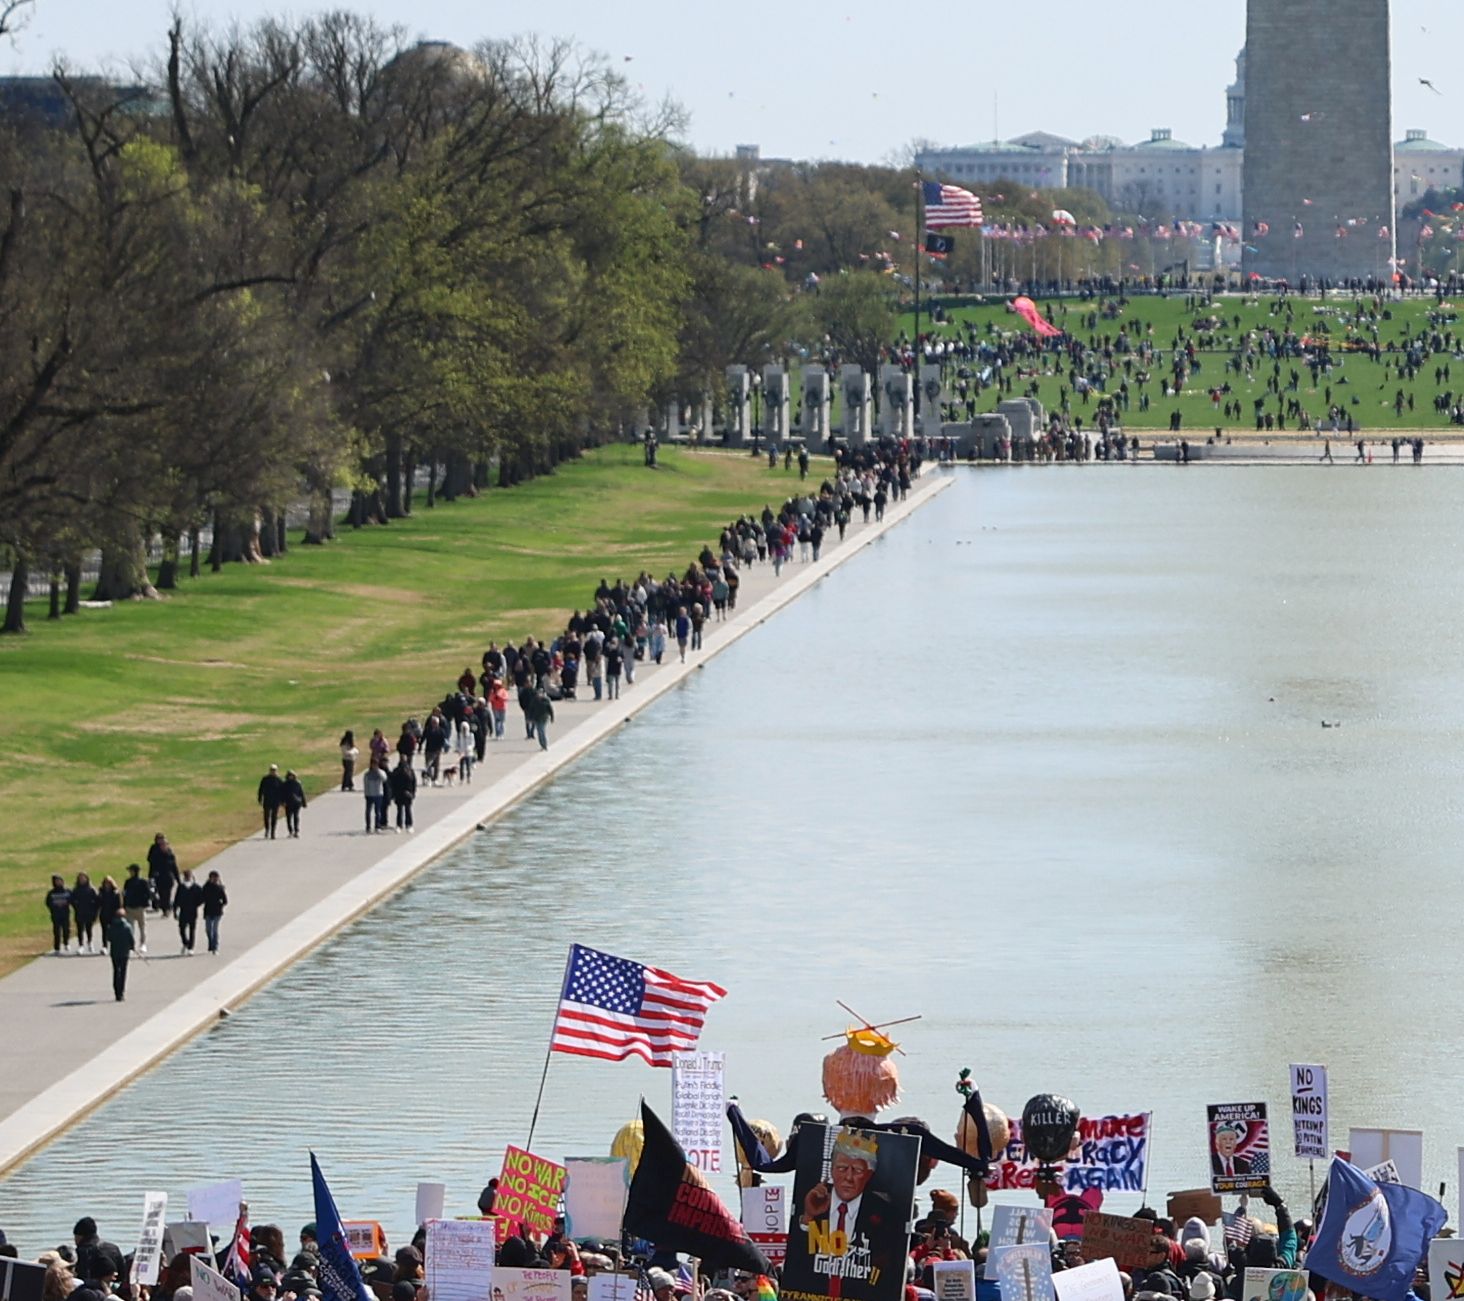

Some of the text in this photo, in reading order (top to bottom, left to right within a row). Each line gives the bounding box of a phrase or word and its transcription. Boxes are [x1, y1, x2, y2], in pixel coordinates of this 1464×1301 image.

[1296, 1067, 1314, 1086] NO
[1217, 1105, 1244, 1113] WAKE
[1292, 1095, 1323, 1115] KINGS
[1030, 1112, 1071, 1127] KILLER
[1214, 1111, 1261, 1121] AMERICA!
[1301, 1119, 1324, 1134] TRUMP
[1303, 1133, 1323, 1145] PUTIN
[504, 1150, 567, 1192] NO WAR
[1067, 1162, 1145, 1192] AGAIN
[499, 1172, 559, 1209] NO ICE
[492, 1193, 520, 1215] NO
[1086, 1212, 1136, 1231] NO KINGS
[1089, 1228, 1148, 1245] NO WAR
[195, 1267, 210, 1285] NO
[534, 1271, 559, 1281] PEOPLE
